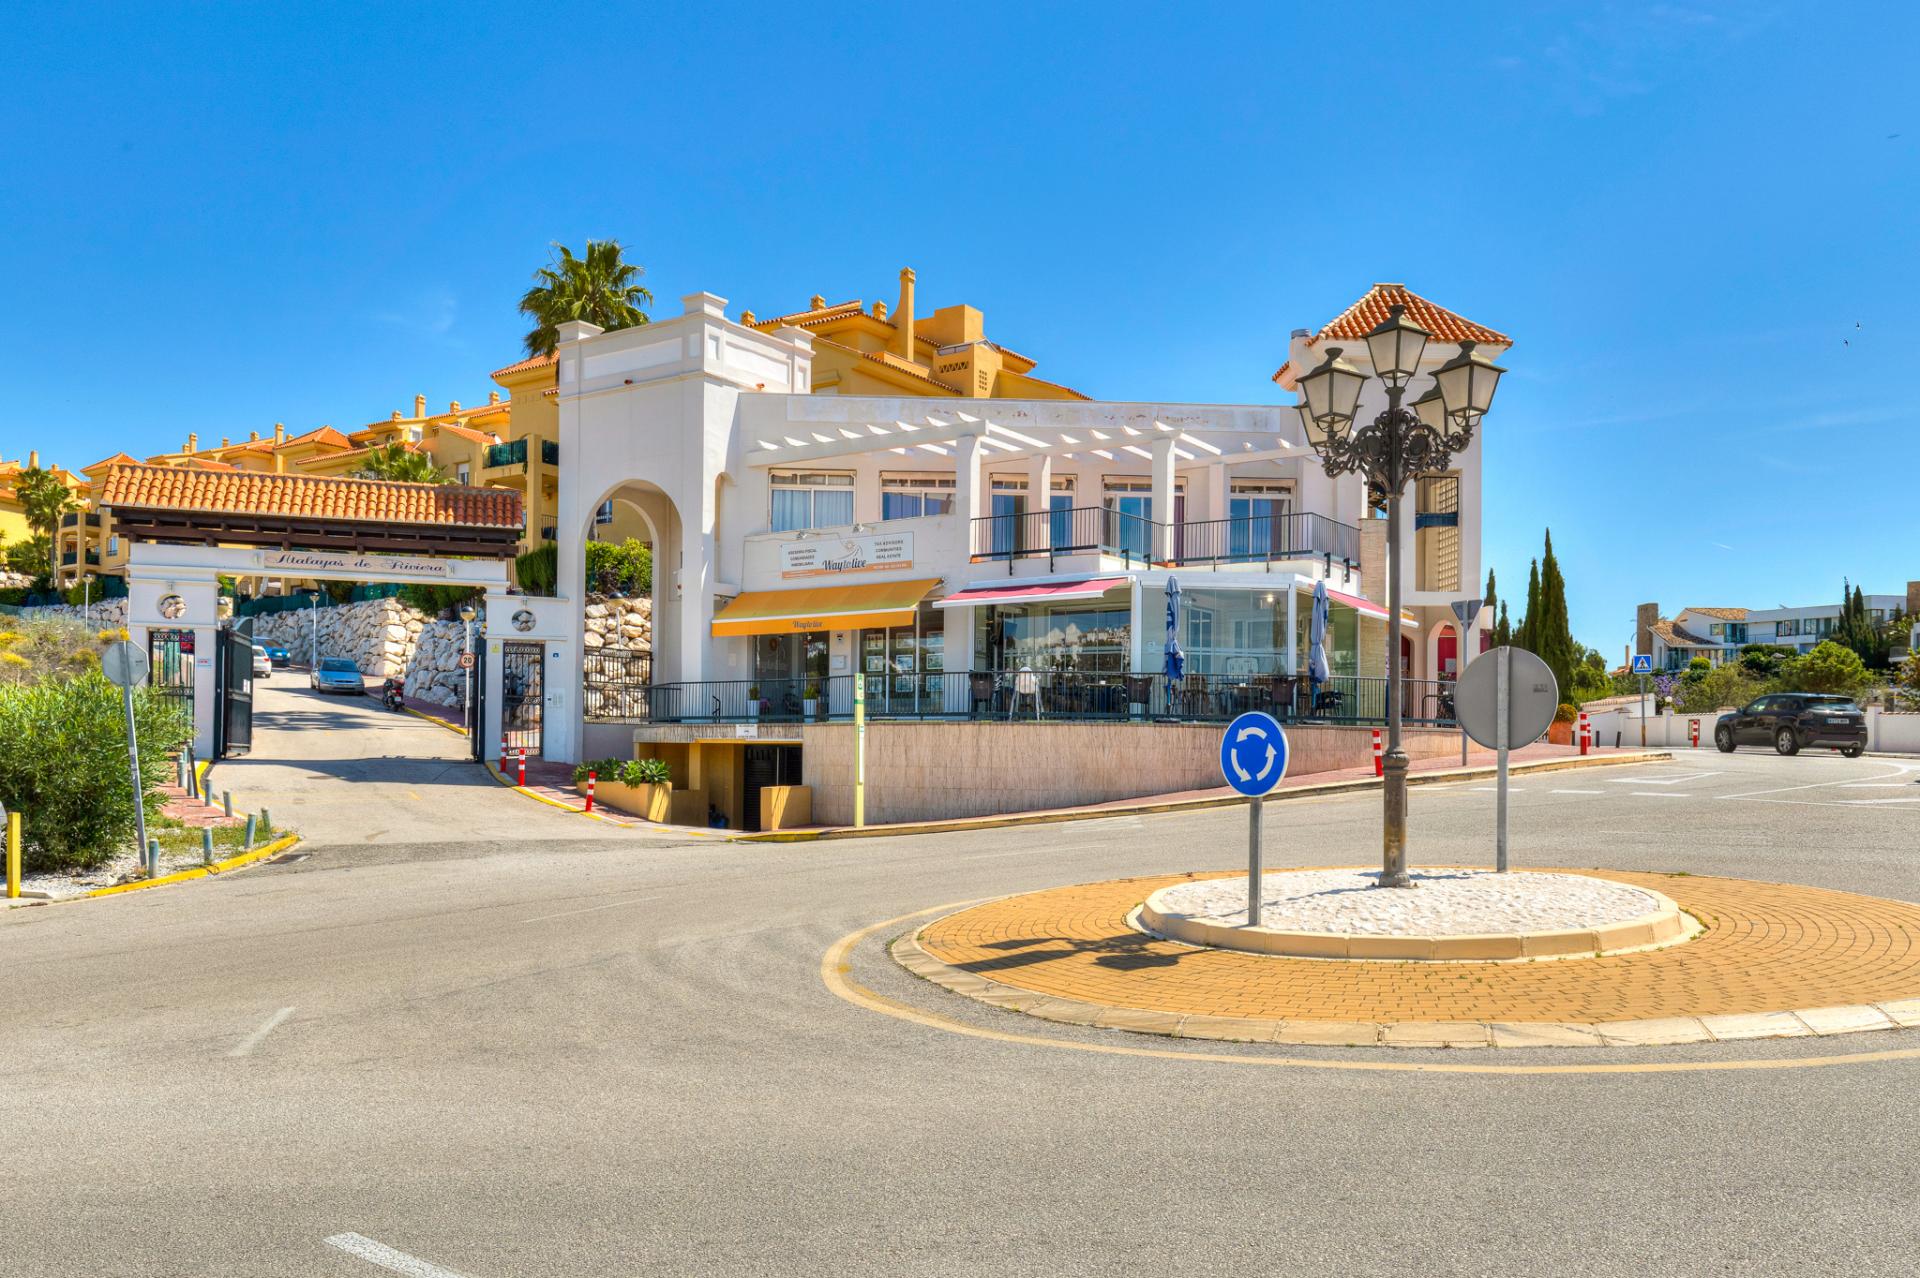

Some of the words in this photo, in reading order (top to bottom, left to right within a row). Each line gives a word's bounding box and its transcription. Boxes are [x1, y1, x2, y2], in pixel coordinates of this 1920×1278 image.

[353, 559, 371, 568] de
[384, 559, 444, 571] Riviera
[463, 656, 472, 664] 20
